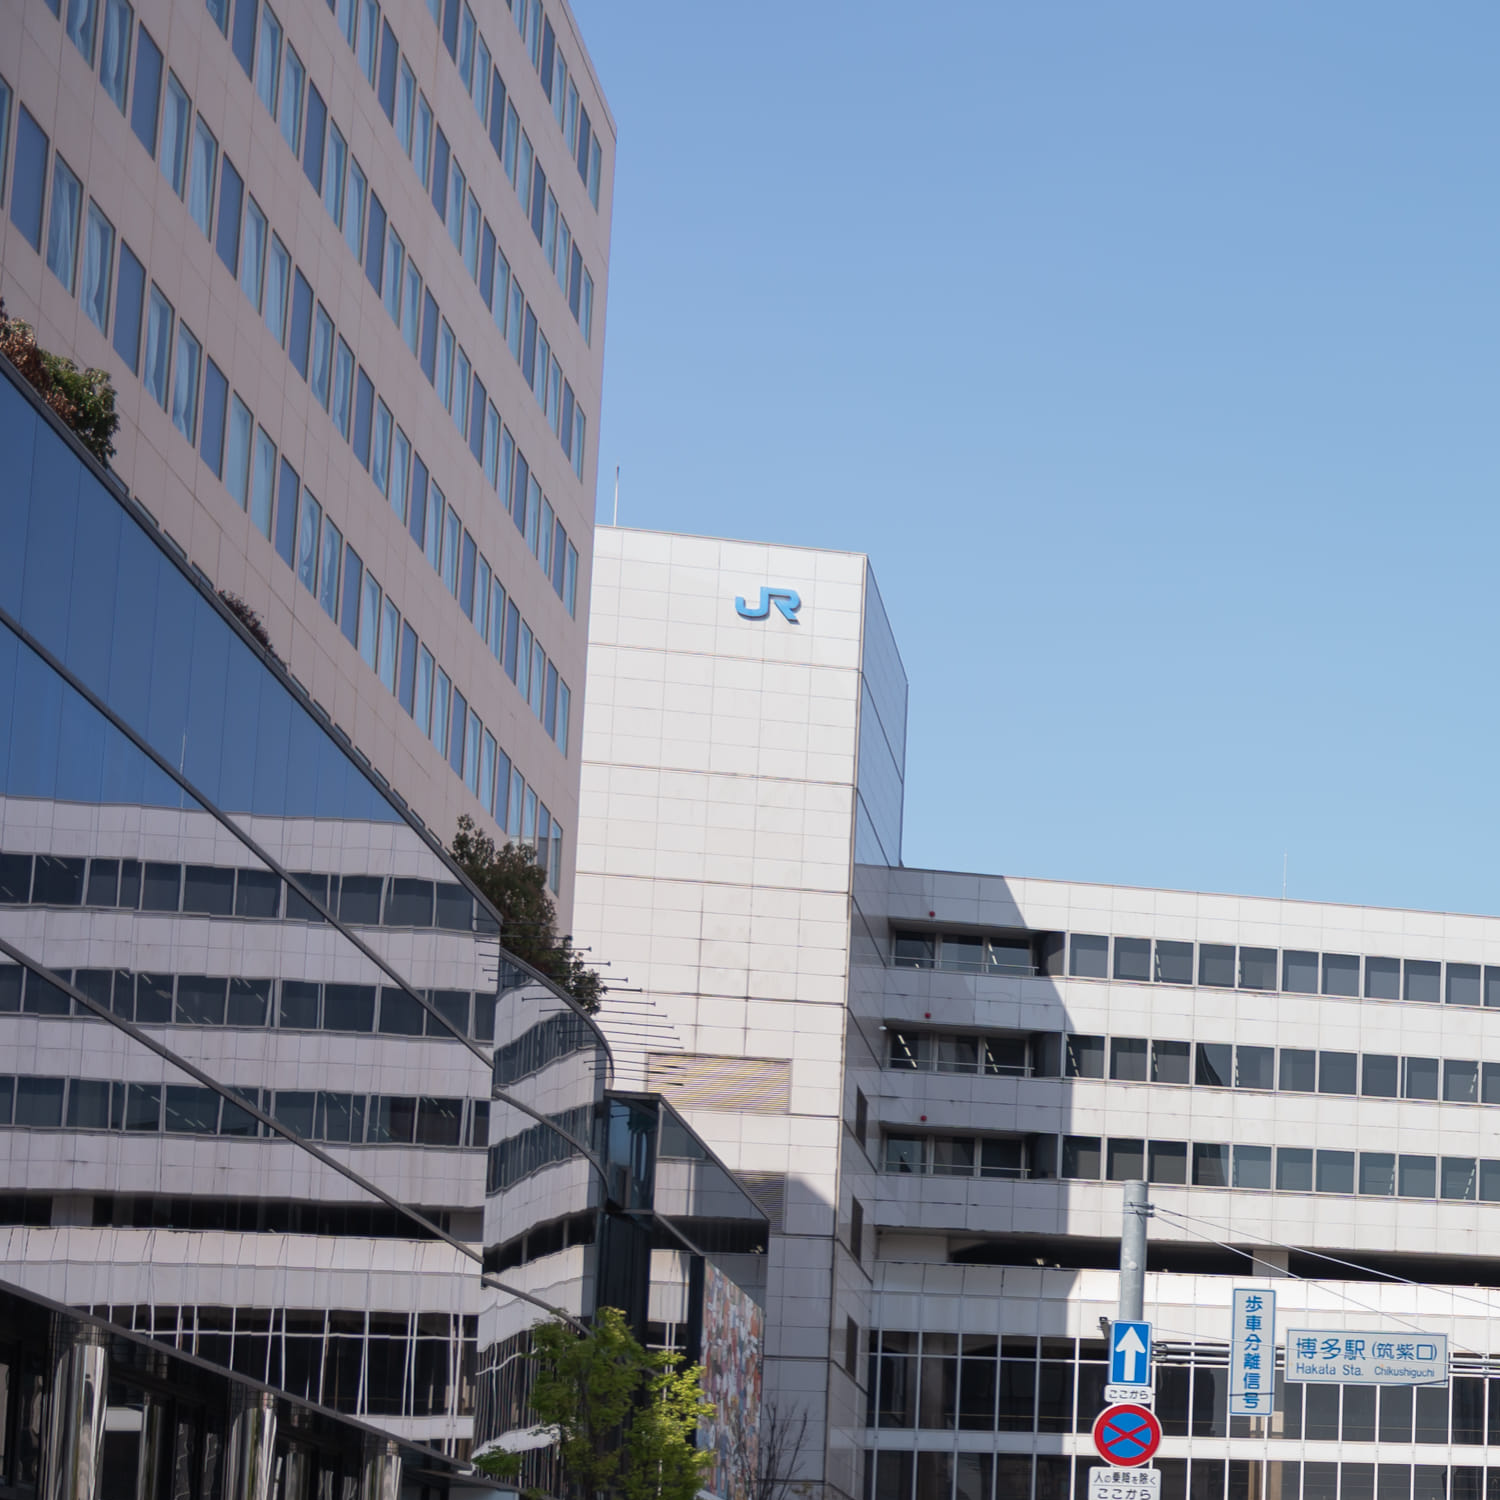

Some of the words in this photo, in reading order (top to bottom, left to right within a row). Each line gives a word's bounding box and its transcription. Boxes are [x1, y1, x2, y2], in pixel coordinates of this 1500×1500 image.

[735, 586, 801, 625] JR
[1243, 1295, 1263, 1409] 歩車分離信号
[1296, 1337, 1438, 1361] 博多駅(筑紫口)
[1296, 1361, 1336, 1376] Hakata
[1342, 1364, 1364, 1377] Sta.
[1374, 1365, 1435, 1379] Chikushiguchi
[1109, 1389, 1149, 1400] ここから
[1094, 1471, 1156, 1485] 人の乗降を除く
[1097, 1487, 1152, 1500] ここから
